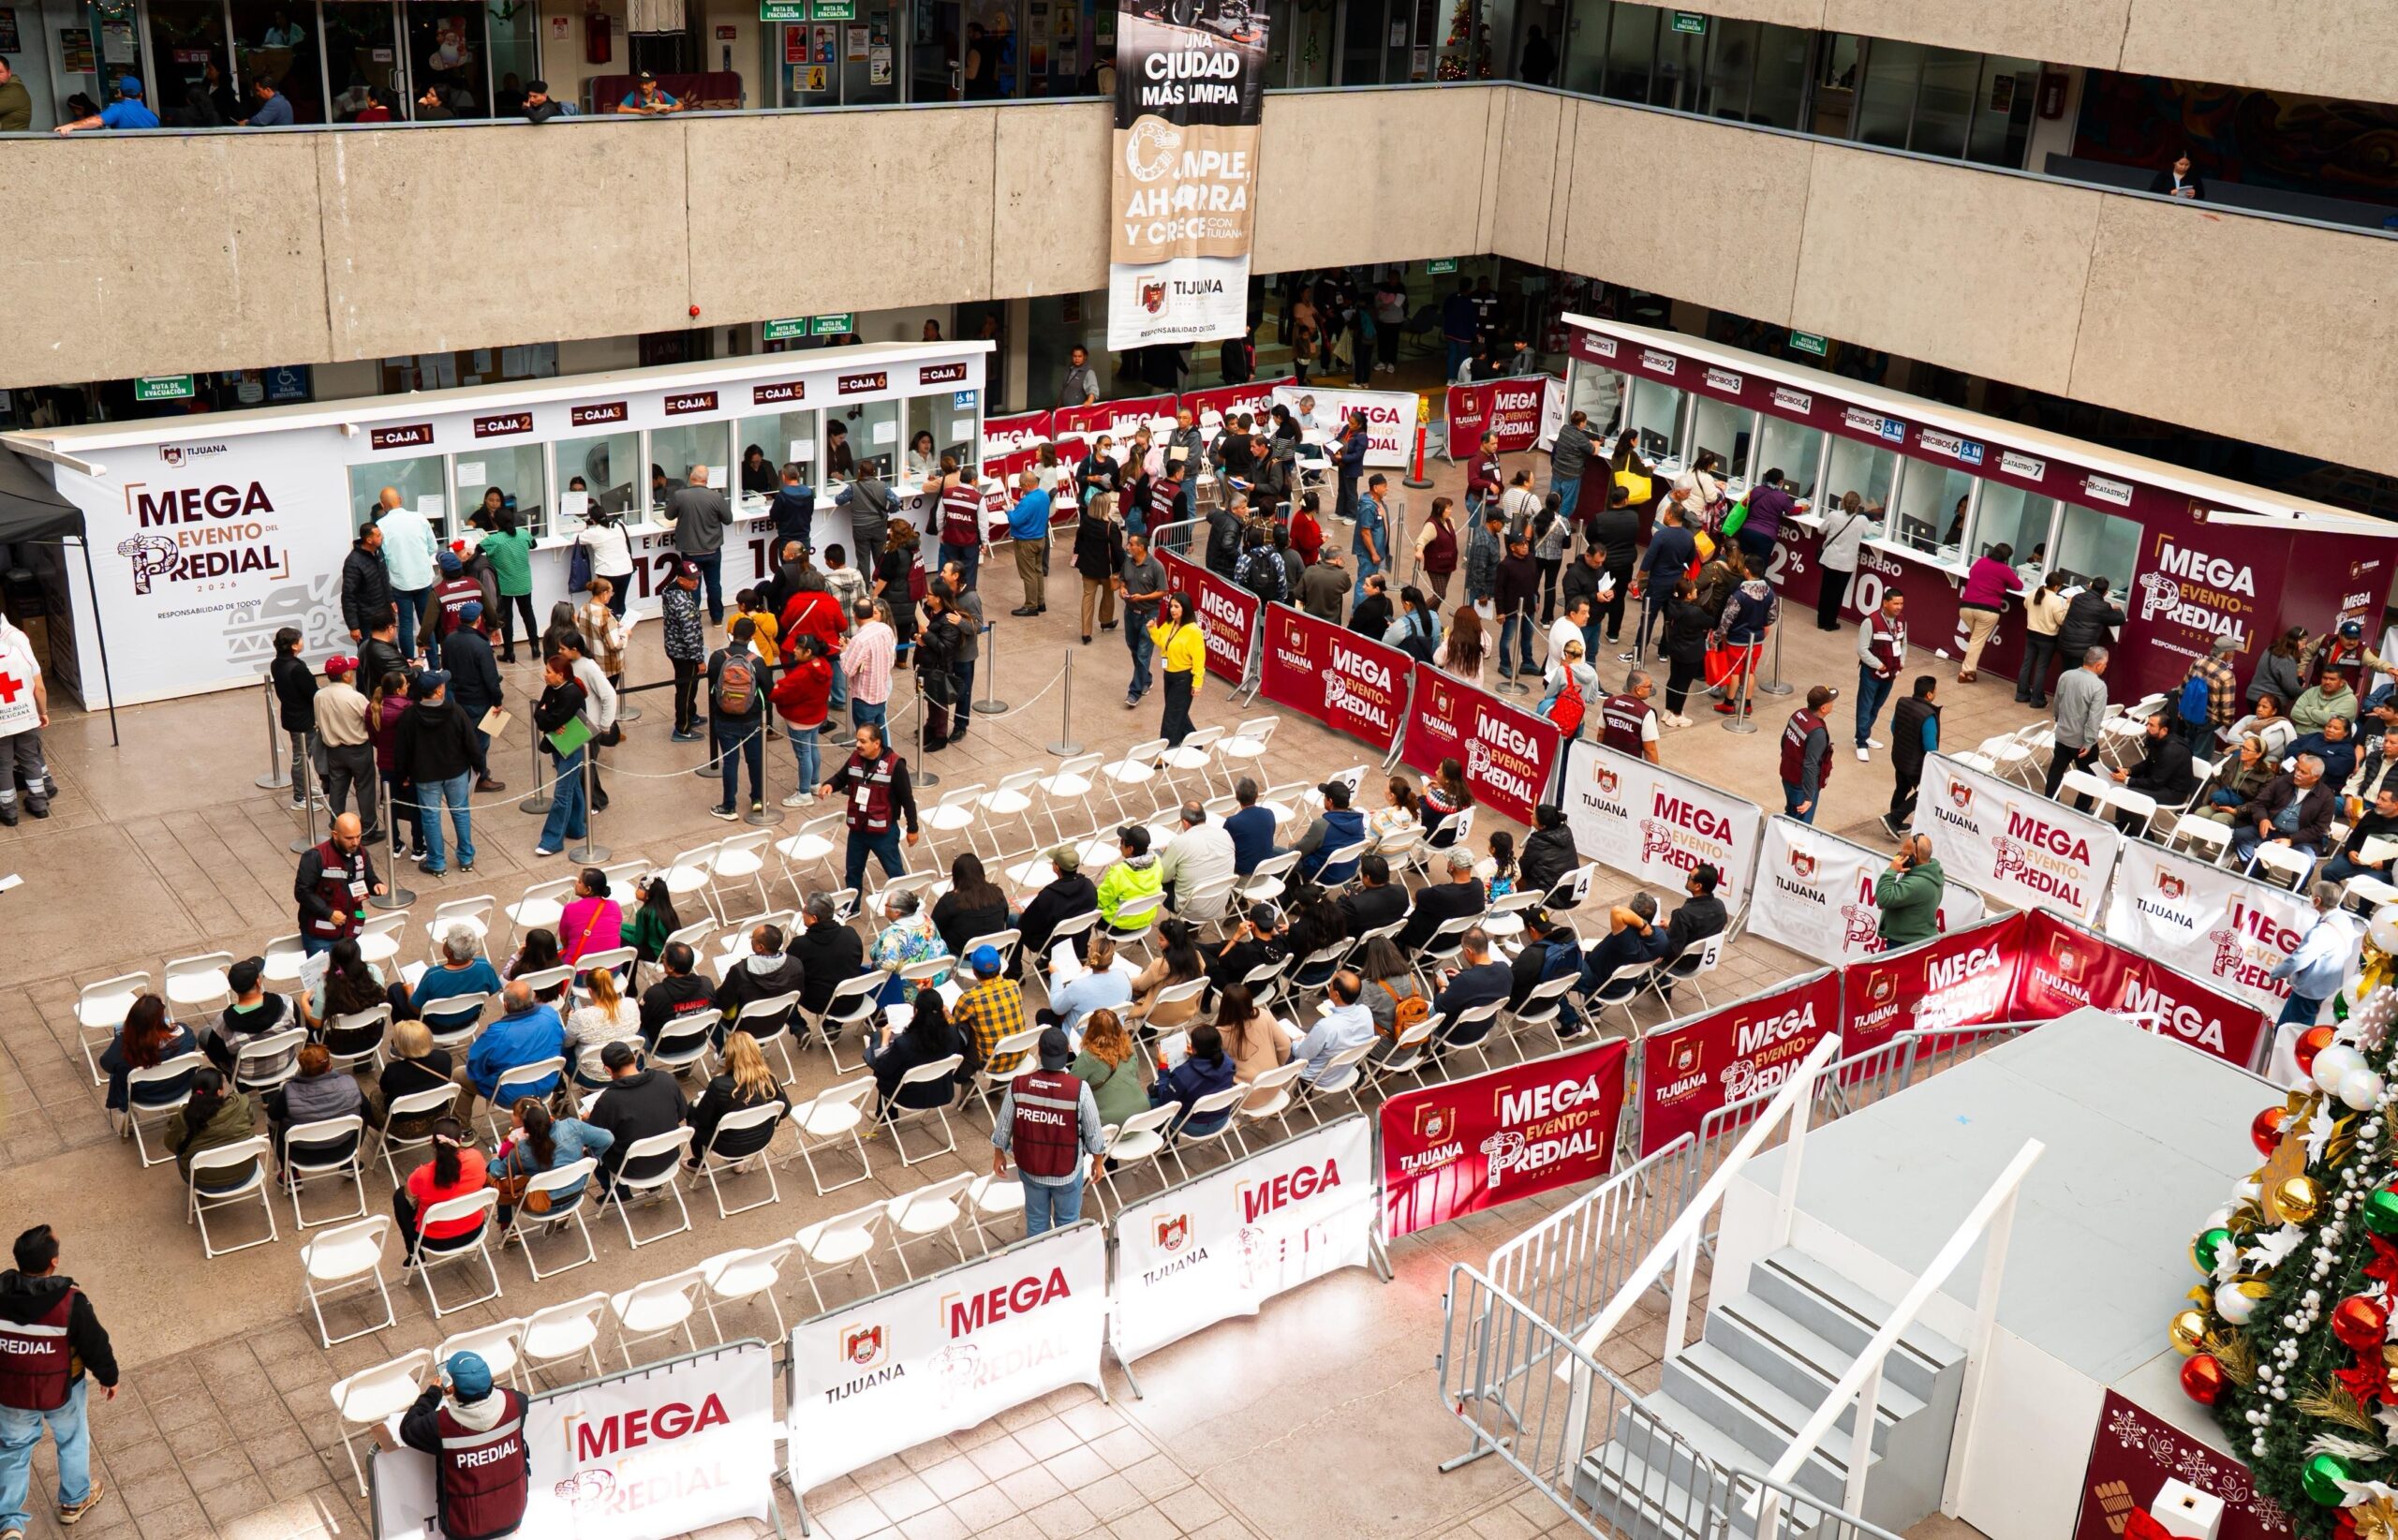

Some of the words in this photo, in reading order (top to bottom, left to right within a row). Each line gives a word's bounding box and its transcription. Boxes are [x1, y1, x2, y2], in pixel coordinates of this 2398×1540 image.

[1185, 33, 1213, 48] UNA
[1145, 52, 1239, 81] CIUDAD
[1142, 81, 1185, 106] MÁS
[1124, 224, 1140, 245] Y
[1207, 217, 1233, 229] CON
[1174, 279, 1223, 295] TIJUANA
[1586, 337, 1609, 351] RECIBOS
[1608, 343, 1614, 355] 1
[930, 367, 956, 380] CAJA
[957, 365, 966, 378] 7
[1644, 355, 1668, 368] RECIBOS
[1666, 359, 1674, 372] 2
[765, 387, 792, 400] CAJA
[793, 384, 803, 397] 5
[850, 377, 876, 390] CAJA
[877, 374, 886, 388] 6
[1709, 373, 1733, 387] RECIBOS
[1732, 378, 1739, 391] 3
[585, 407, 614, 421] CAJA
[613, 406, 621, 419] 3
[677, 397, 705, 410] CAJA
[704, 395, 712, 407] 4
[1236, 395, 1272, 413] MEG
[1496, 392, 1537, 410] MEGA
[1775, 392, 1802, 407] RECIBOS
[1801, 398, 1810, 411] 4
[488, 419, 520, 432] CAJA
[521, 416, 531, 429] 2
[1455, 415, 1482, 426] TIJUANA
[1504, 410, 1532, 421] EVENTO
[1847, 413, 1874, 427] RECIBOS
[1873, 420, 1882, 432] 5
[386, 431, 420, 444] CAJA
[422, 427, 430, 441] 1
[1367, 437, 1399, 451] DIAL
[1922, 435, 1952, 450] RECIBOS
[1951, 441, 1960, 453] 6
[186, 445, 228, 456] TIJUANA
[2002, 458, 2033, 472] CATASTRO
[2034, 464, 2043, 477] 7
[138, 481, 274, 527] MEGA
[178, 522, 262, 549] EVENTO
[118, 533, 279, 595] PREDIAL
[2159, 543, 2255, 598] MEGA
[157, 605, 224, 620] RESPONSABILIDAD
[226, 602, 235, 611] DE
[237, 600, 261, 609] TODOS
[1200, 588, 1245, 632] MEGA
[2139, 571, 2245, 643] PREDIAL
[2180, 583, 2242, 613] EVENTO
[2343, 591, 2371, 611] MEGA
[1211, 618, 1239, 644] EVENTO
[1277, 647, 1312, 671] TIJUANA
[1332, 645, 1392, 693] MEGA
[1322, 668, 1389, 729] PREDIAL
[1345, 679, 1384, 705] EVENTO
[0, 706, 12, 715] RUZ
[1422, 712, 1458, 739] TIJUANA
[1477, 713, 1539, 764] MEGA
[1464, 737, 1533, 804] PREDIAL
[1490, 748, 1531, 777] EVENTO
[1348, 778, 1356, 794] 2
[1582, 792, 1628, 820] TIJUANA
[1653, 792, 1733, 846] MEGA
[1458, 821, 1467, 837] 3
[1934, 806, 1979, 836] TIJUANA
[1639, 818, 1727, 887] PREDL
[1672, 830, 1724, 860] EVENTO
[2007, 811, 2090, 866] MEGA
[1991, 835, 2082, 909] PREDIAL
[2025, 848, 2080, 881] EVENTO
[1576, 878, 1588, 895] 4
[1776, 875, 1826, 906] TIJUANA
[2137, 897, 2194, 929] TIJUANA
[2232, 903, 2302, 954] MEG
[1705, 948, 1716, 965] 5
[1929, 942, 2001, 992] MEGA
[2210, 929, 2292, 1000] PREDI
[2035, 967, 2090, 1005] TIJUANA
[1737, 1001, 1816, 1057] MEGA
[1855, 1003, 1899, 1029] TIJUANA
[2124, 979, 2226, 1054] MEGA
[1754, 1037, 1806, 1070] EVENTO
[1656, 1072, 1707, 1101] TIJUANA
[1720, 1058, 1808, 1106] PREDIA
[1502, 1074, 1600, 1128] MEGA
[1016, 1107, 1066, 1126] PREDIAL
[1526, 1110, 1588, 1141] EVENTO
[1590, 1109, 1600, 1118] DEL
[1399, 1141, 1464, 1171] TIJUANA
[1480, 1129, 1597, 1189] PREDIAL
[1244, 1158, 1341, 1224] MEGA
[1143, 1247, 1208, 1288] TIJUANA
[951, 1266, 1071, 1340] MEGA
[0, 1340, 56, 1355] REDIAL
[825, 1363, 905, 1404] TIJUANA
[578, 1392, 731, 1462] MEGA
[456, 1438, 518, 1469] PREDIAL
